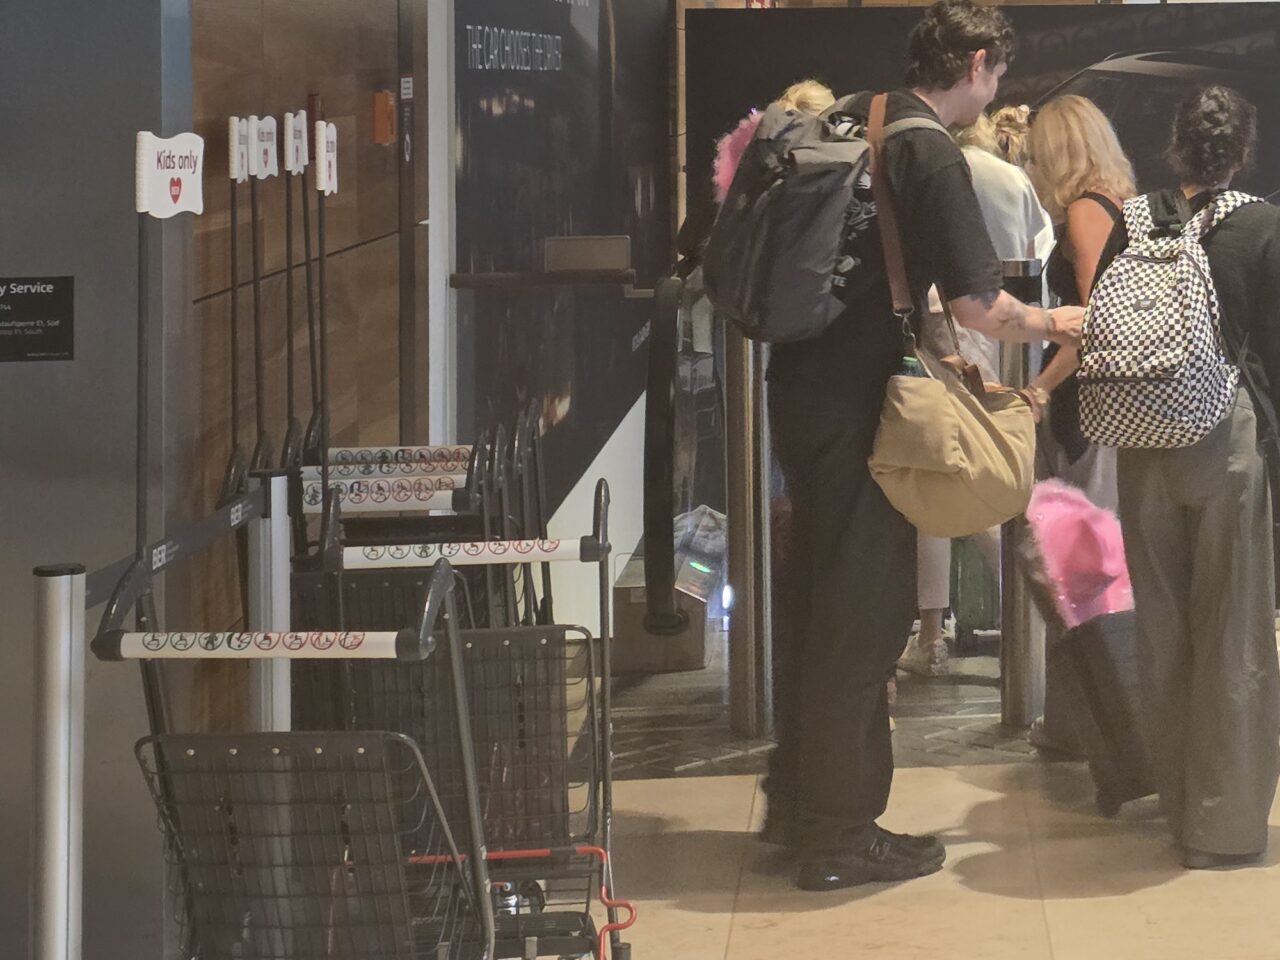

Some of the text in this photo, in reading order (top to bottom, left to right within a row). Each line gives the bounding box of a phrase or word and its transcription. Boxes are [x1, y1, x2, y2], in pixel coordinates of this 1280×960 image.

[156, 150, 198, 174] Kids only
[9, 282, 54, 294] Service
